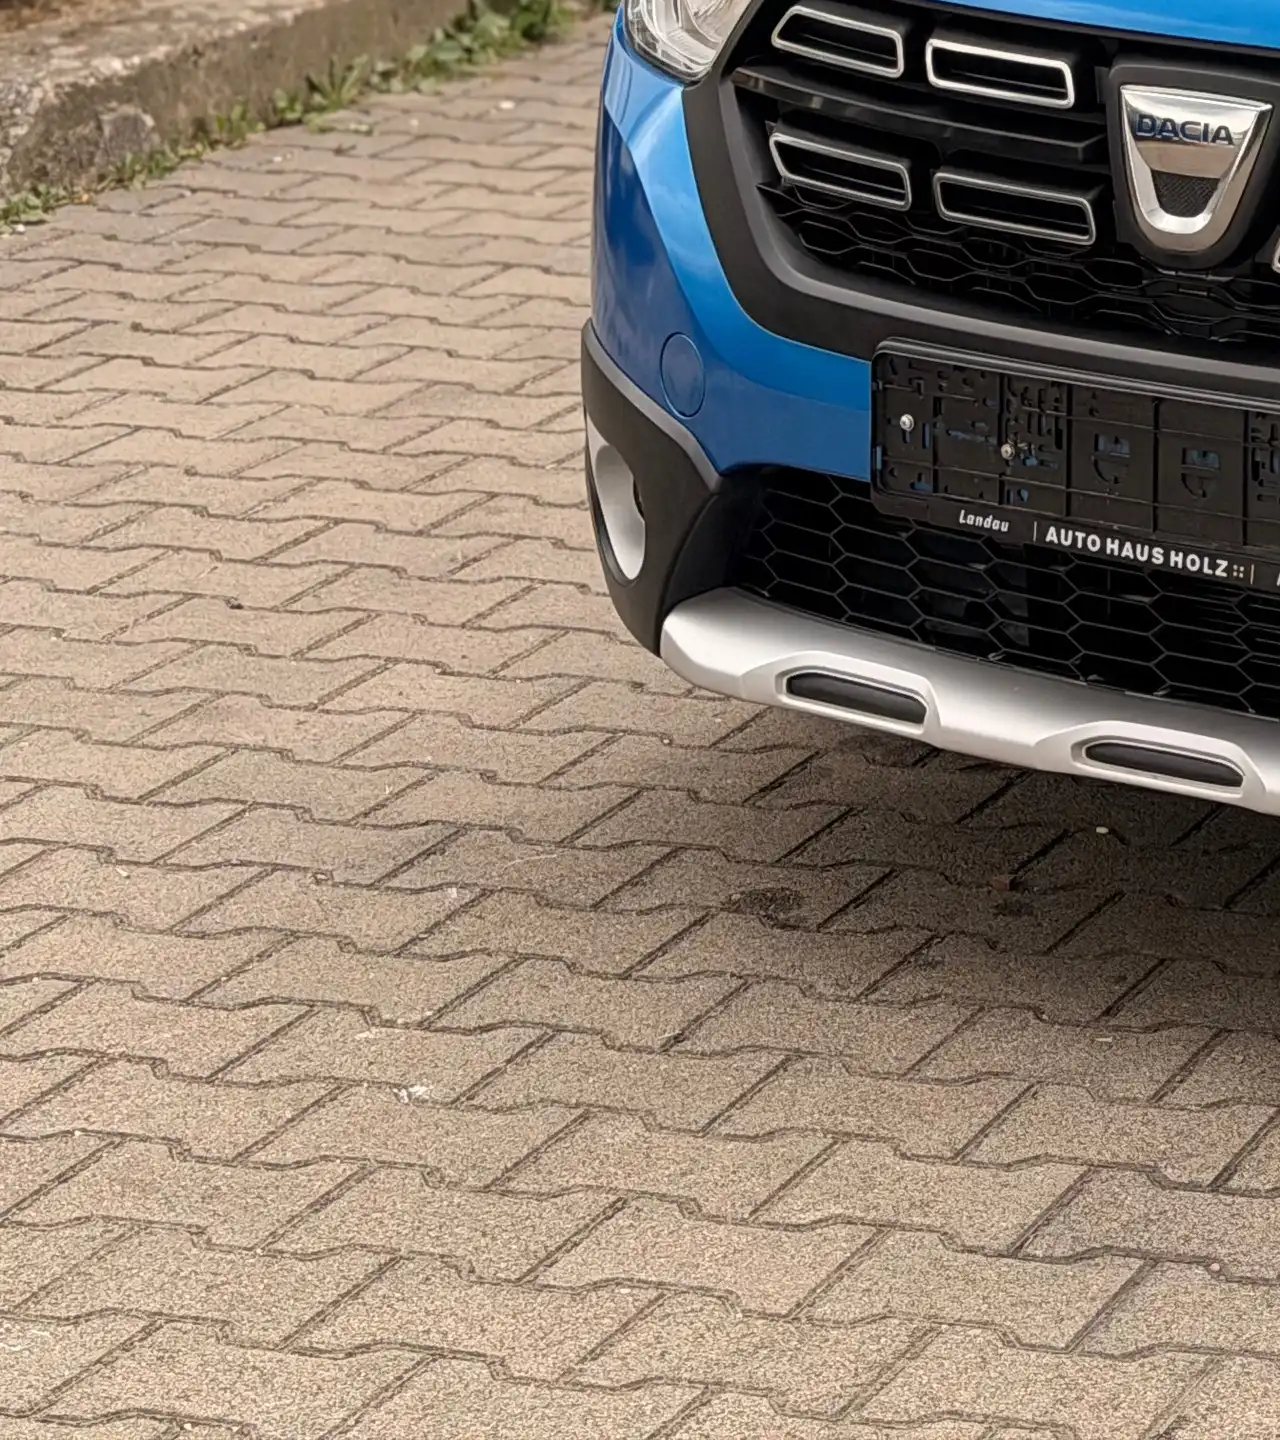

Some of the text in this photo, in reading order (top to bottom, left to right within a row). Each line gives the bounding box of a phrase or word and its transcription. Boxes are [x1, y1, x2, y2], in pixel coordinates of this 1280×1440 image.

[1135, 113, 1236, 146] DACIA
[958, 509, 1010, 533] Landau
[1044, 525, 1101, 553] AUTO
[1105, 538, 1165, 565] HAUS
[1168, 549, 1229, 578] HOLZ
